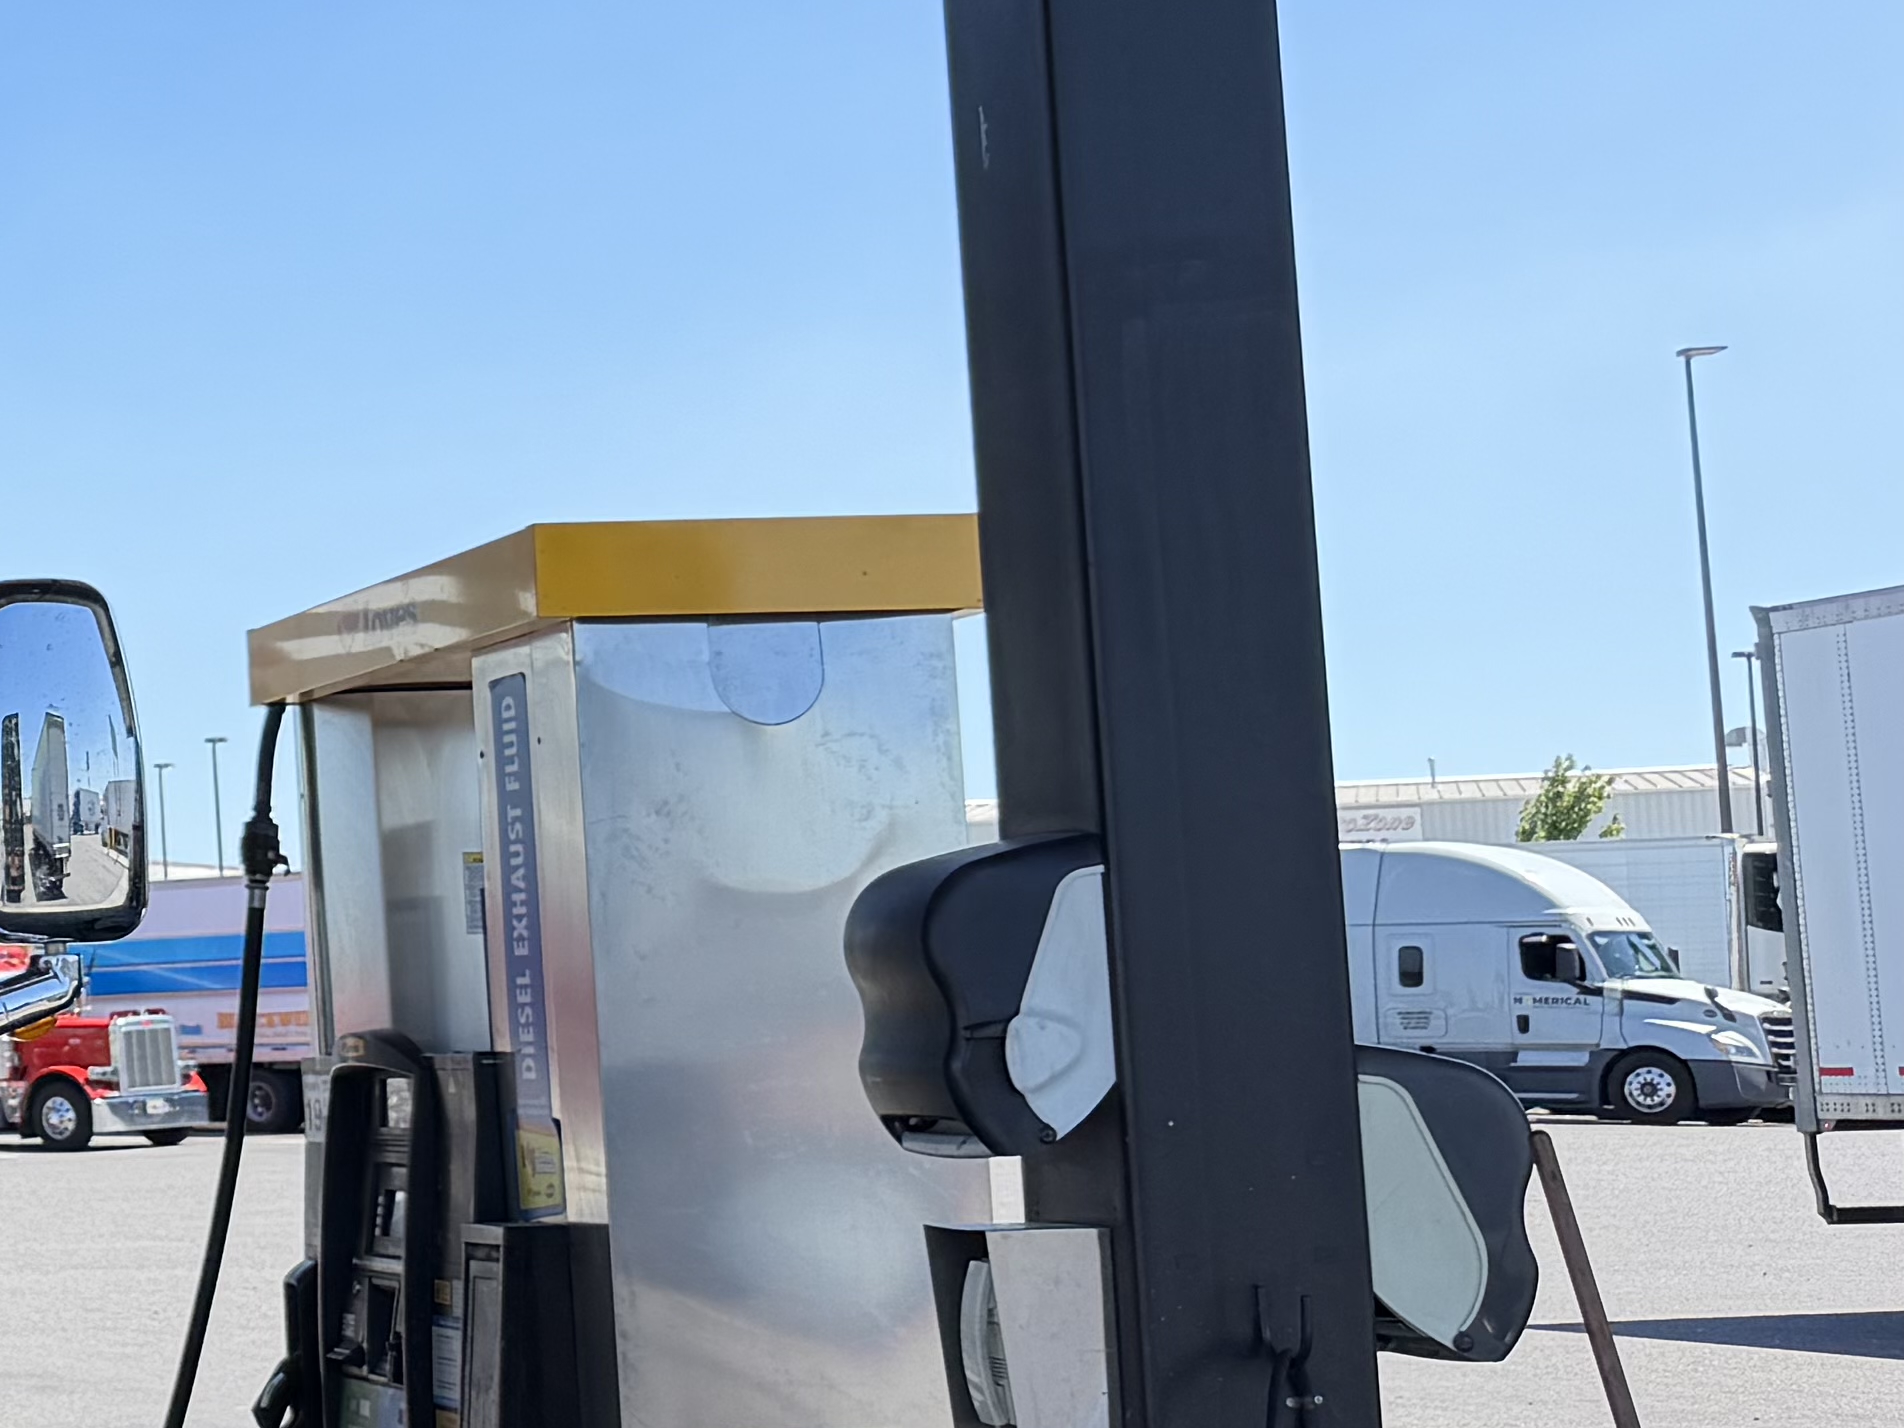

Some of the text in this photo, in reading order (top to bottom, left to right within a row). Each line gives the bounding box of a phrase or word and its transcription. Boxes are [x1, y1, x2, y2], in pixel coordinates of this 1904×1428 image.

[503, 695, 522, 792] FLUID
[507, 805, 530, 956] EXHAUST
[516, 969, 537, 1082] DIESEL
